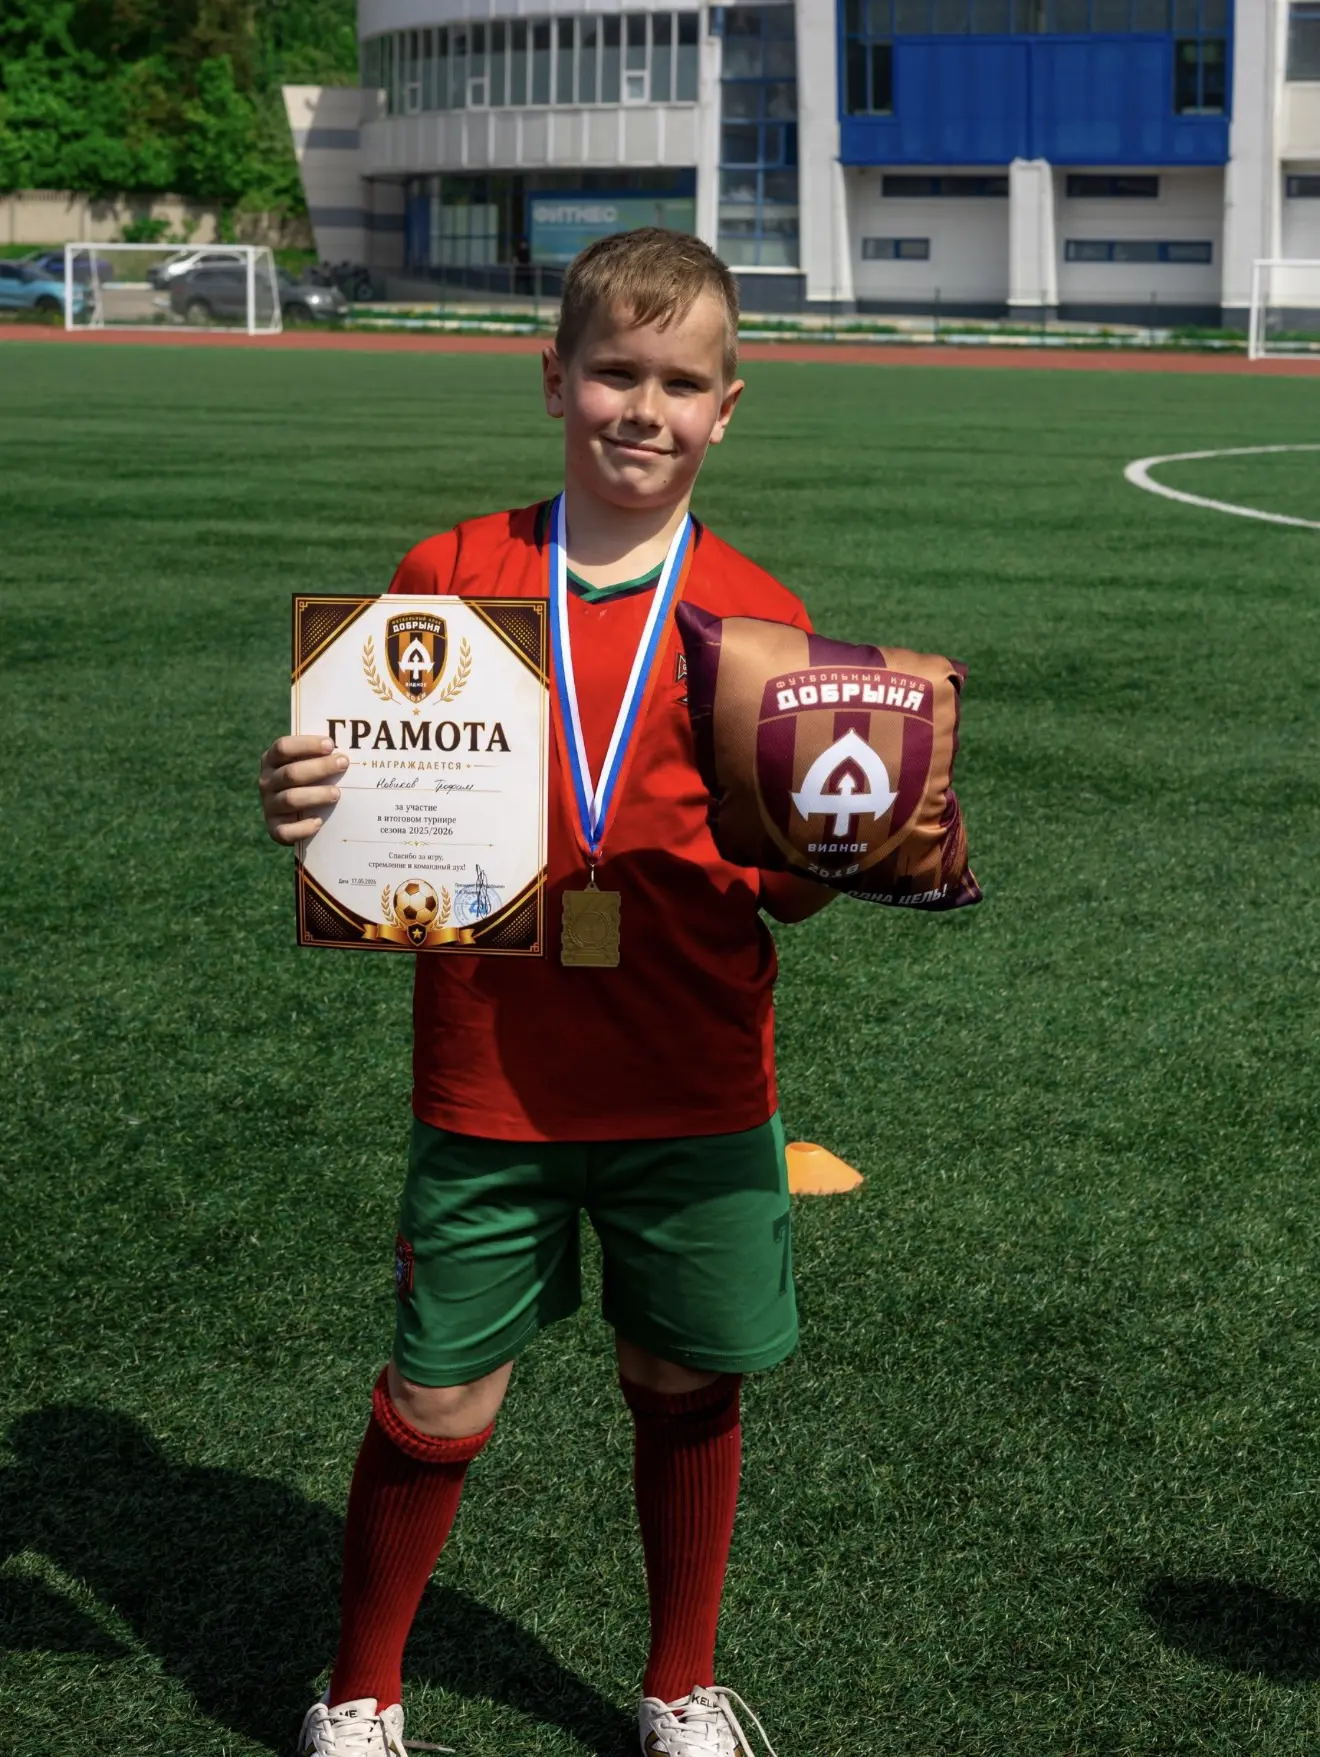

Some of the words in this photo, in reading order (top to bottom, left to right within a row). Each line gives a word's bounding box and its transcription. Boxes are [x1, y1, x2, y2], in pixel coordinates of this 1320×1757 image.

[392, 621, 441, 633] ДОБРЫНЯ
[776, 673, 881, 689] ФУТБОЛЬНЫЙ
[890, 676, 926, 691] КЛУБ
[776, 683, 925, 711] ДОБРЫНЯ
[326, 719, 512, 753] ГРАМОТА
[371, 760, 462, 771] НАГРАЖДАЕТСЯ
[376, 776, 420, 789] Новиков
[405, 804, 438, 813] участие
[424, 817, 457, 826] турнире
[409, 826, 454, 836] 2025/2026
[807, 843, 869, 853] ВИДНОЕ
[388, 852, 417, 860] Спасибо
[427, 854, 444, 862] игру,
[368, 862, 406, 870] стремление
[452, 864, 466, 872] дух!
[898, 884, 948, 905] ЦЕЛЬ!
